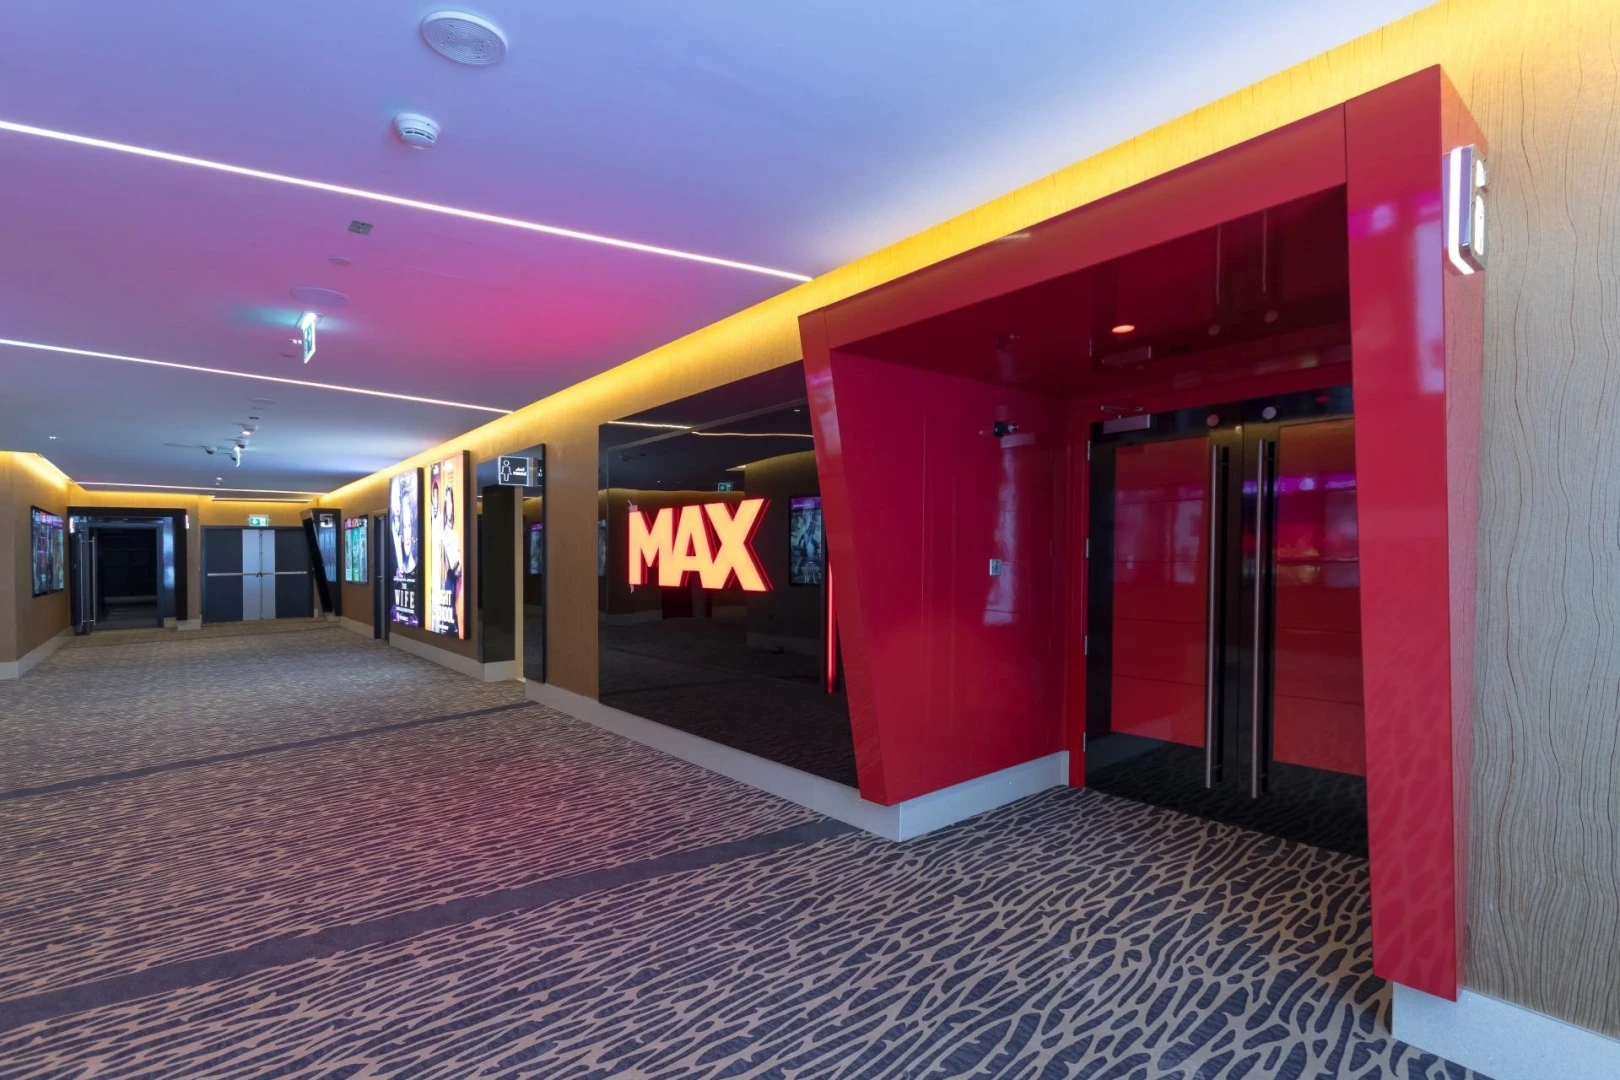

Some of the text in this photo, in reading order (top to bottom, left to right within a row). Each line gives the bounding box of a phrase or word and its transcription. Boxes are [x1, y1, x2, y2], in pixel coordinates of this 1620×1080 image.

[320, 514, 333, 527] 5
[628, 498, 771, 592] MAX
[394, 589, 415, 608] WIFE
